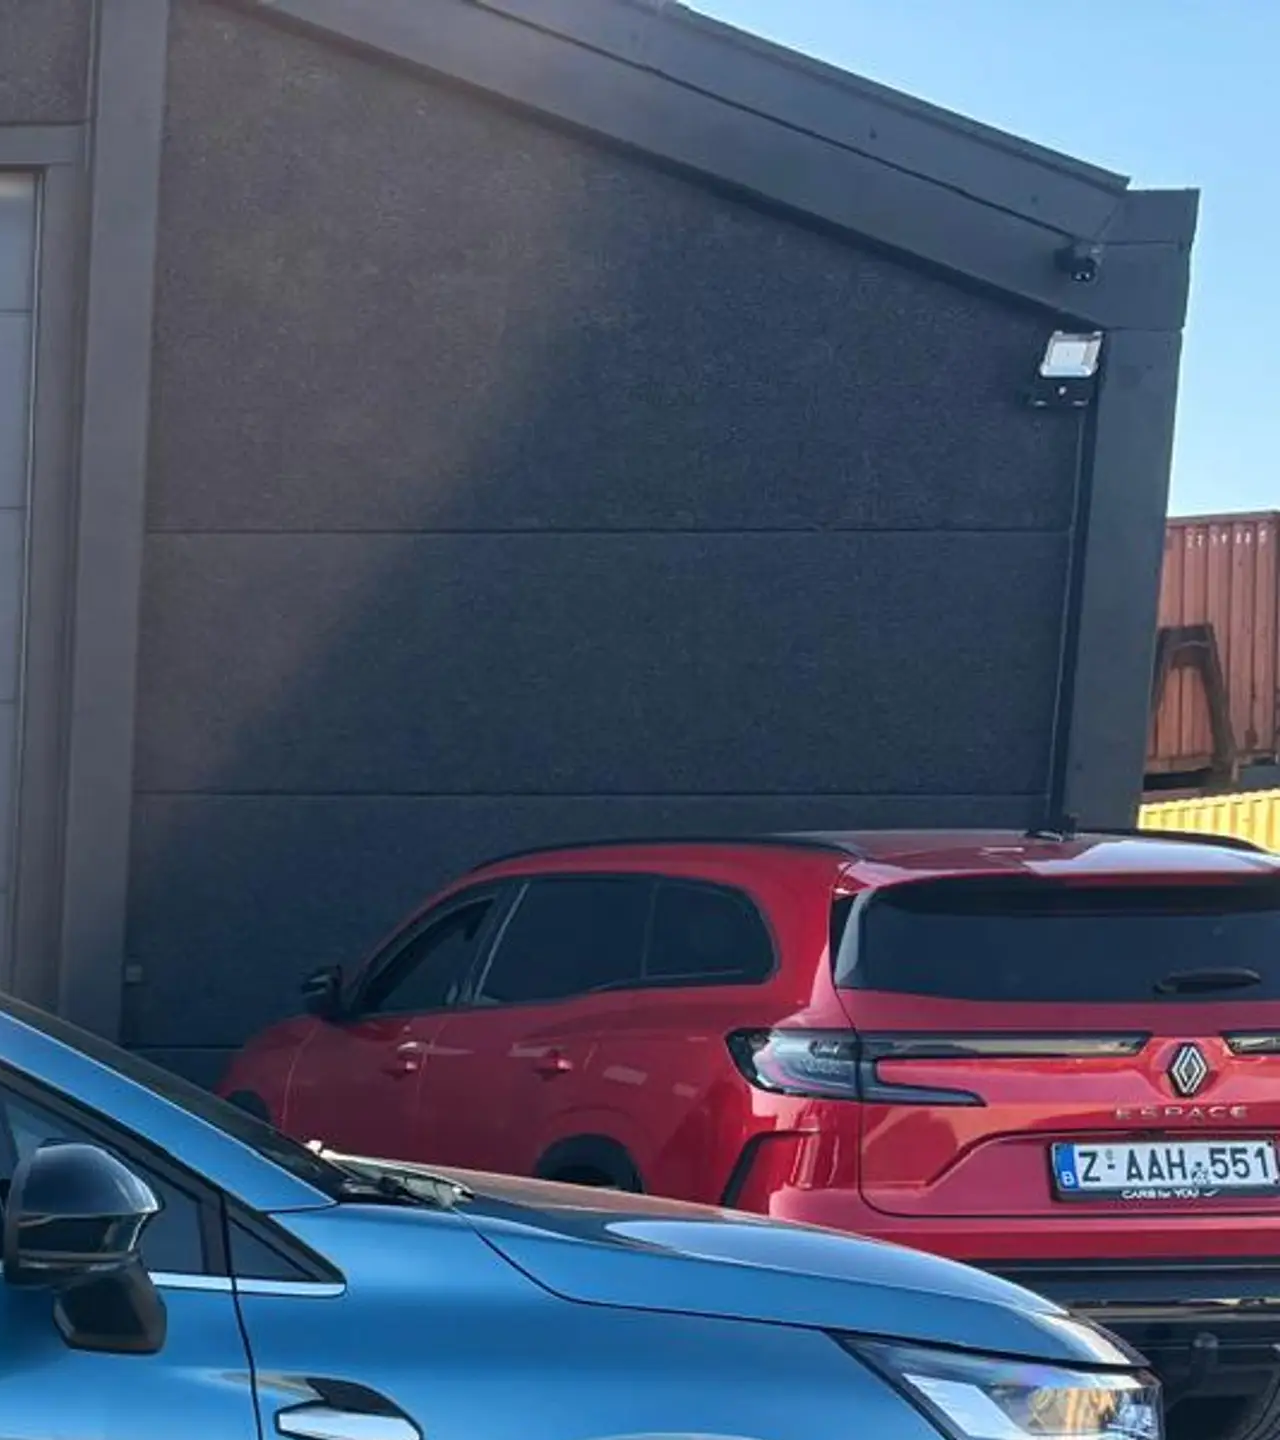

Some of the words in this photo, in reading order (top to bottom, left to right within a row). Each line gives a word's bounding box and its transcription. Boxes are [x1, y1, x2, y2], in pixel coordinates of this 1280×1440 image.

[1115, 1105, 1248, 1120] ESPACE
[1061, 1171, 1074, 1185] B
[1173, 1189, 1201, 1198] YOU
